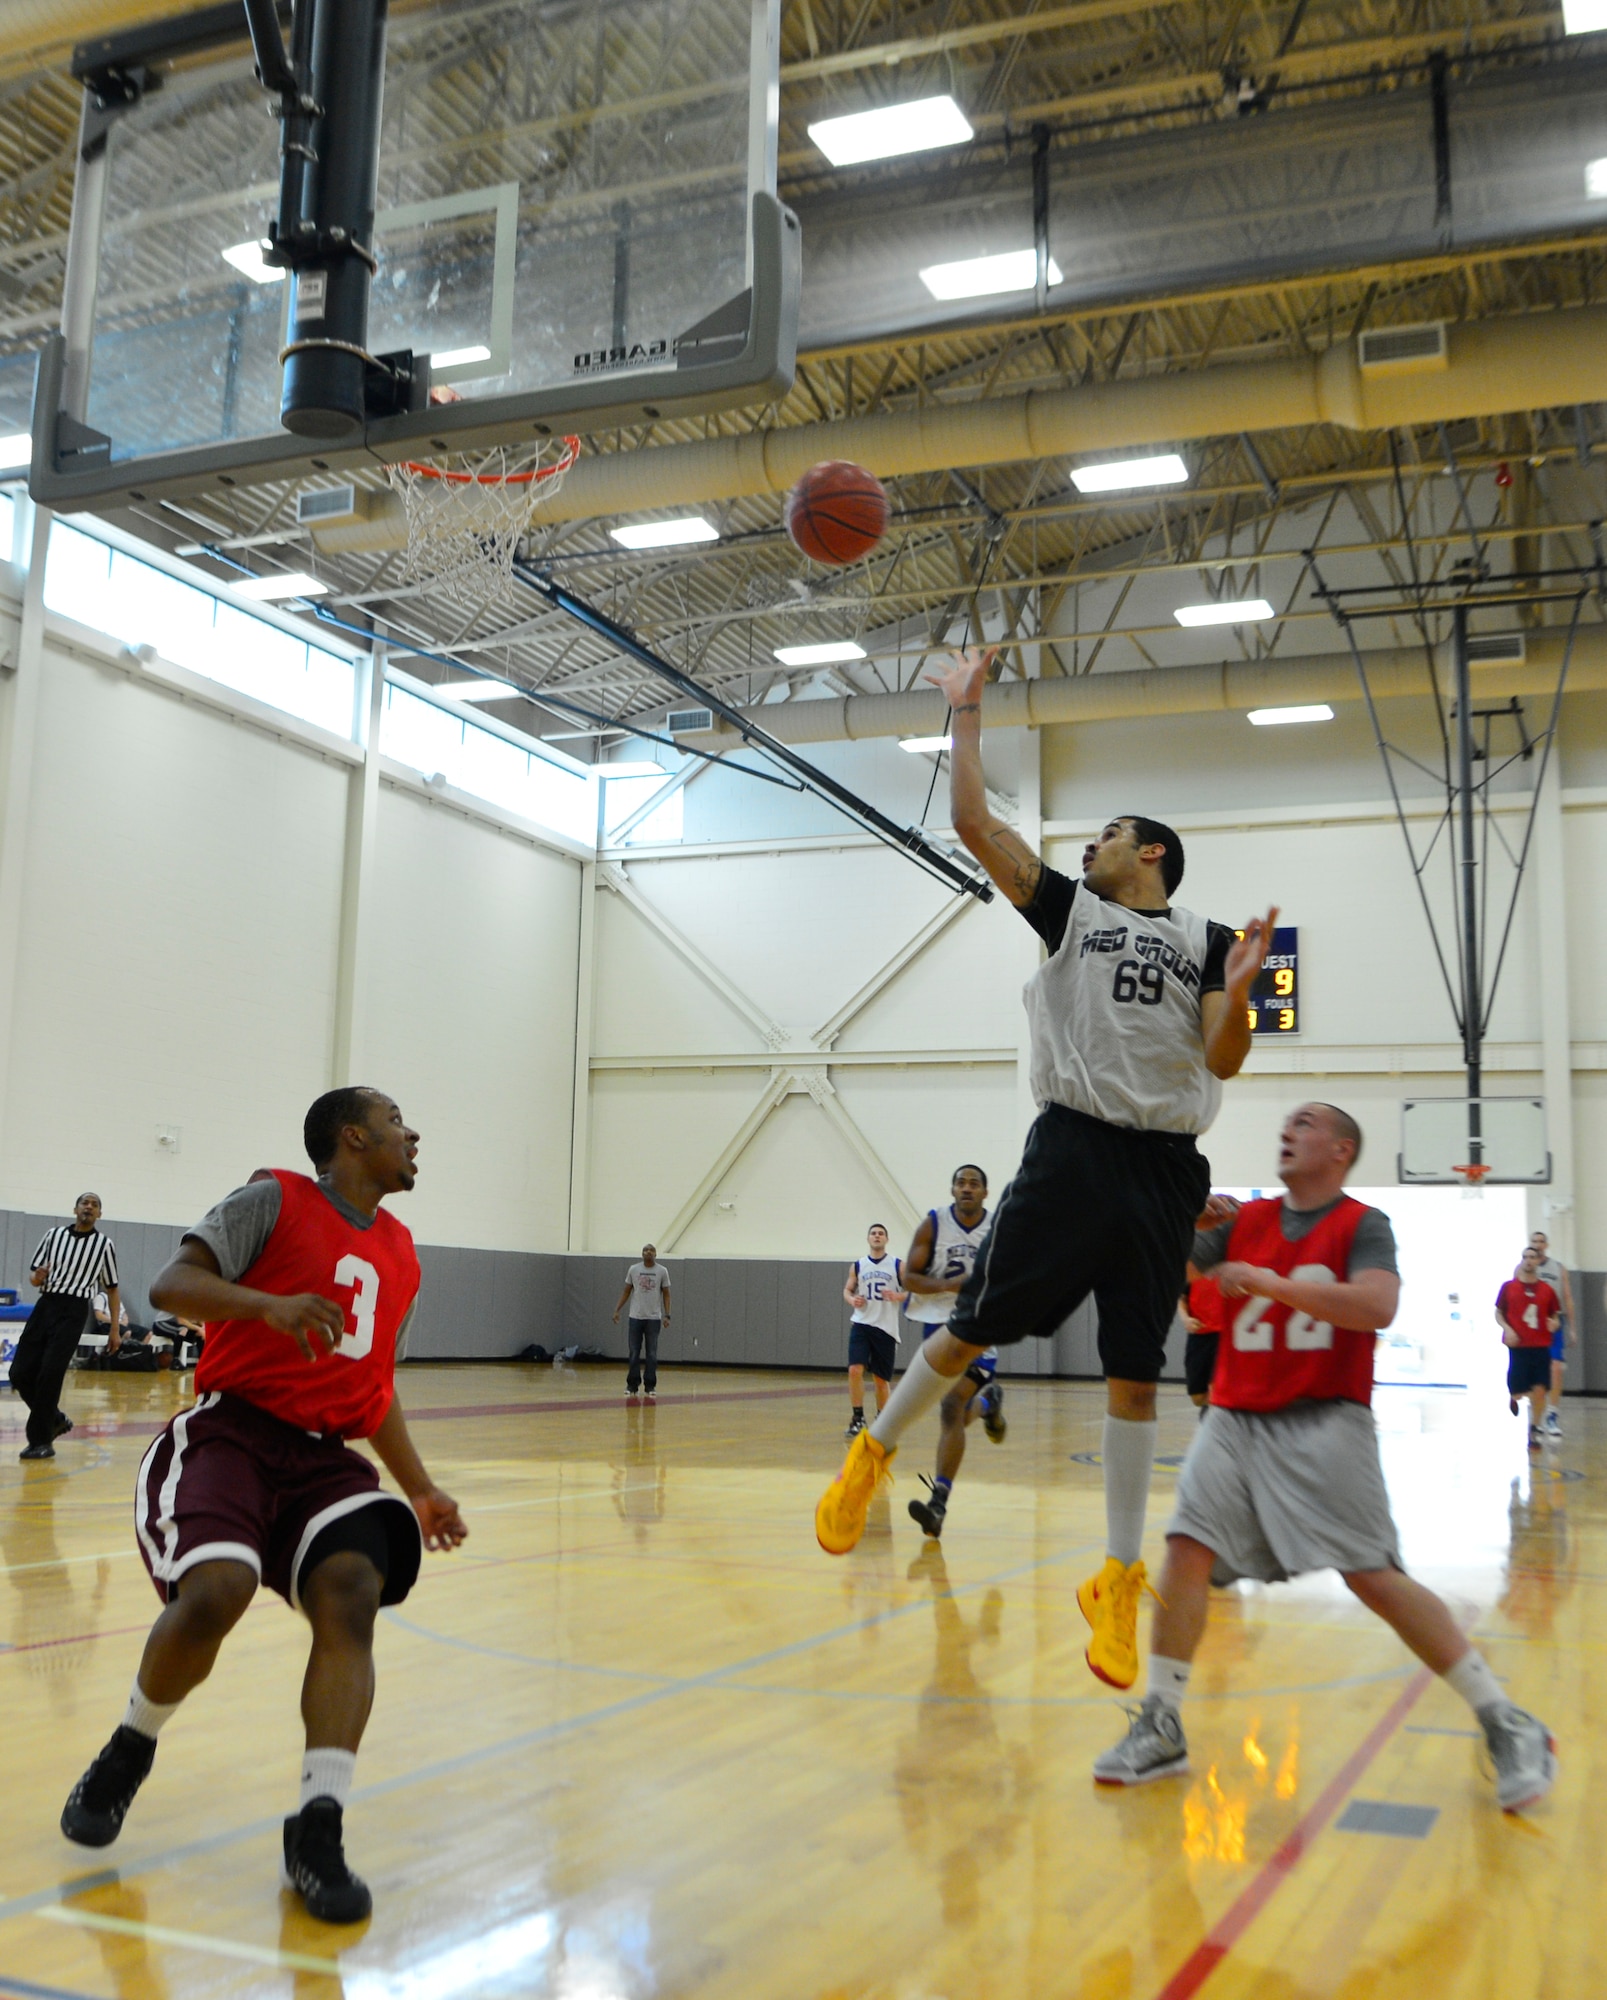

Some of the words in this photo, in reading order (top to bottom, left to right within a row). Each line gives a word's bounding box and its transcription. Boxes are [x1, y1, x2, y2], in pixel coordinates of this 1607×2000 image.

[1080, 926, 1128, 958] MED
[1134, 934, 1201, 988] GROUP
[1261, 955, 1297, 969] UEST
[1112, 959, 1165, 1005] 69
[1274, 969, 1294, 996] 9
[1264, 998, 1294, 1010] FOULS
[1278, 1008, 1295, 1031] 3
[866, 1282, 887, 1301] 15
[333, 1252, 380, 1361] 3
[1522, 1302, 1539, 1330] 4
